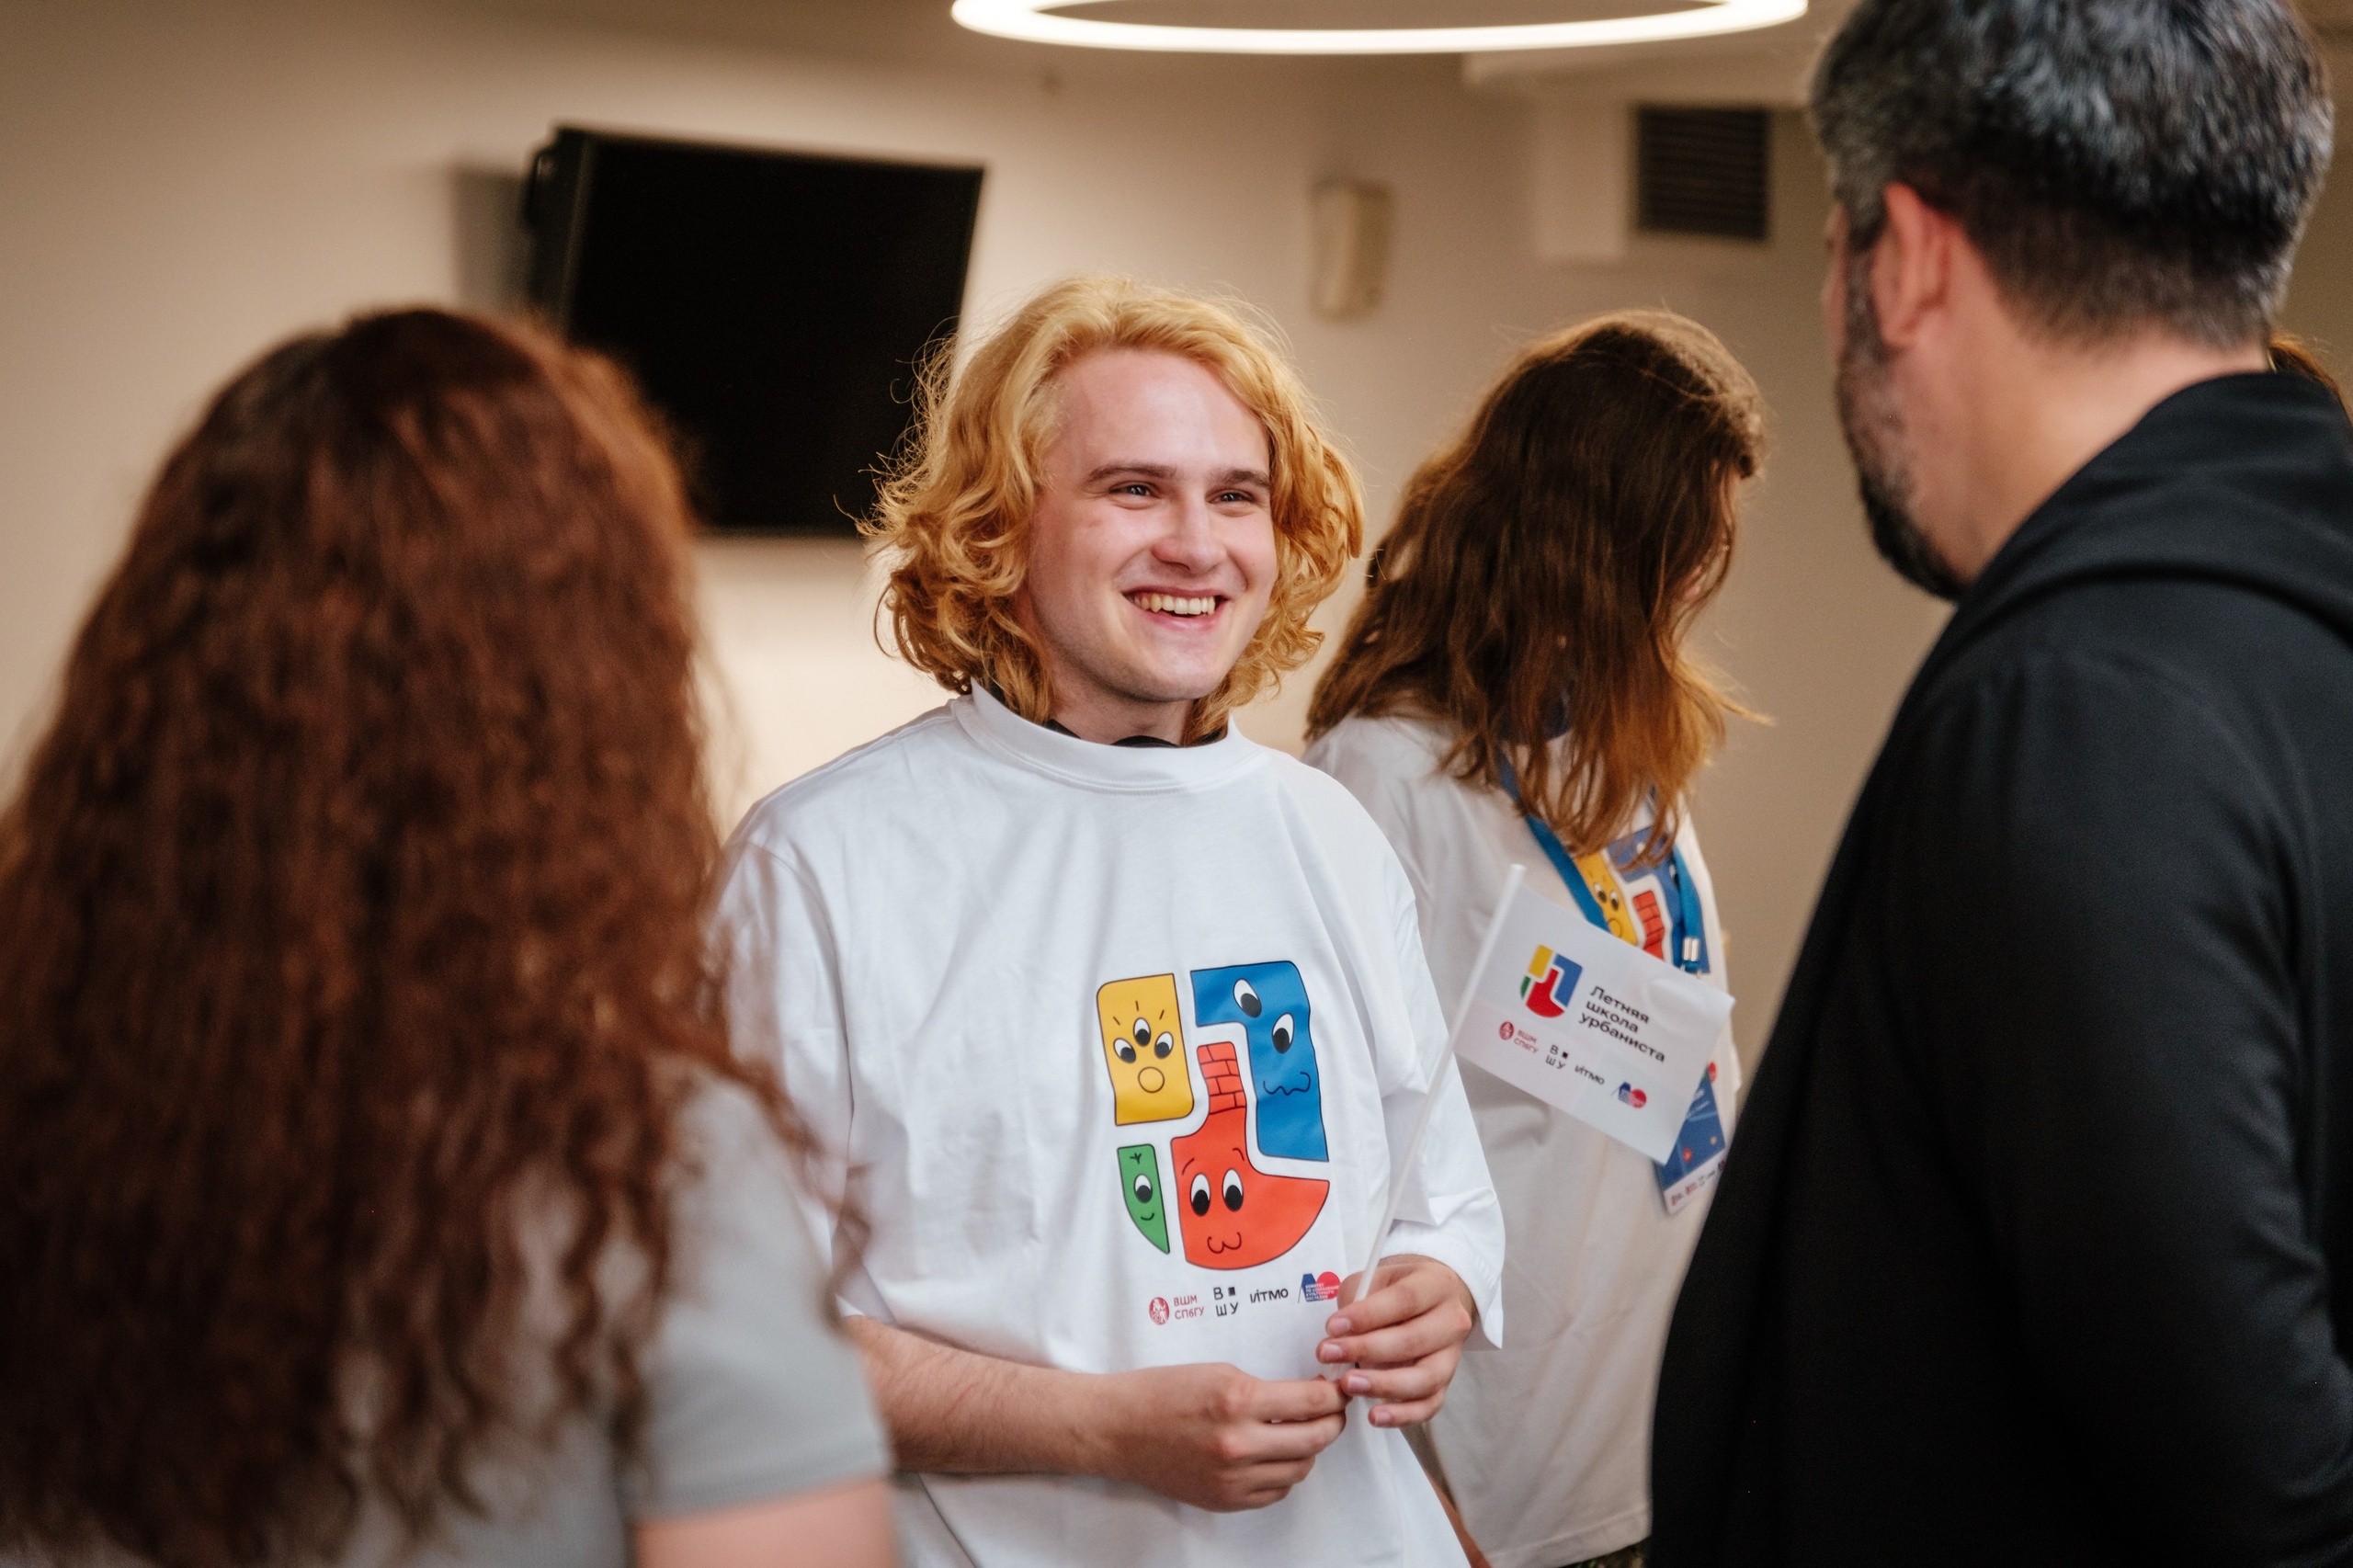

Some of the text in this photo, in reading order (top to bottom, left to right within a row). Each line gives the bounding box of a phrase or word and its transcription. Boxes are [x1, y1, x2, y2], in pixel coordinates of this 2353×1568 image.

[1590, 985, 1650, 1024] Летняя
[1586, 1001, 1639, 1033] школа
[1579, 1013, 1665, 1062] урбаниста
[1174, 1295, 1198, 1306] ВШМ
[1213, 1287, 1223, 1301] В
[1175, 1307, 1204, 1320] СПбГУ
